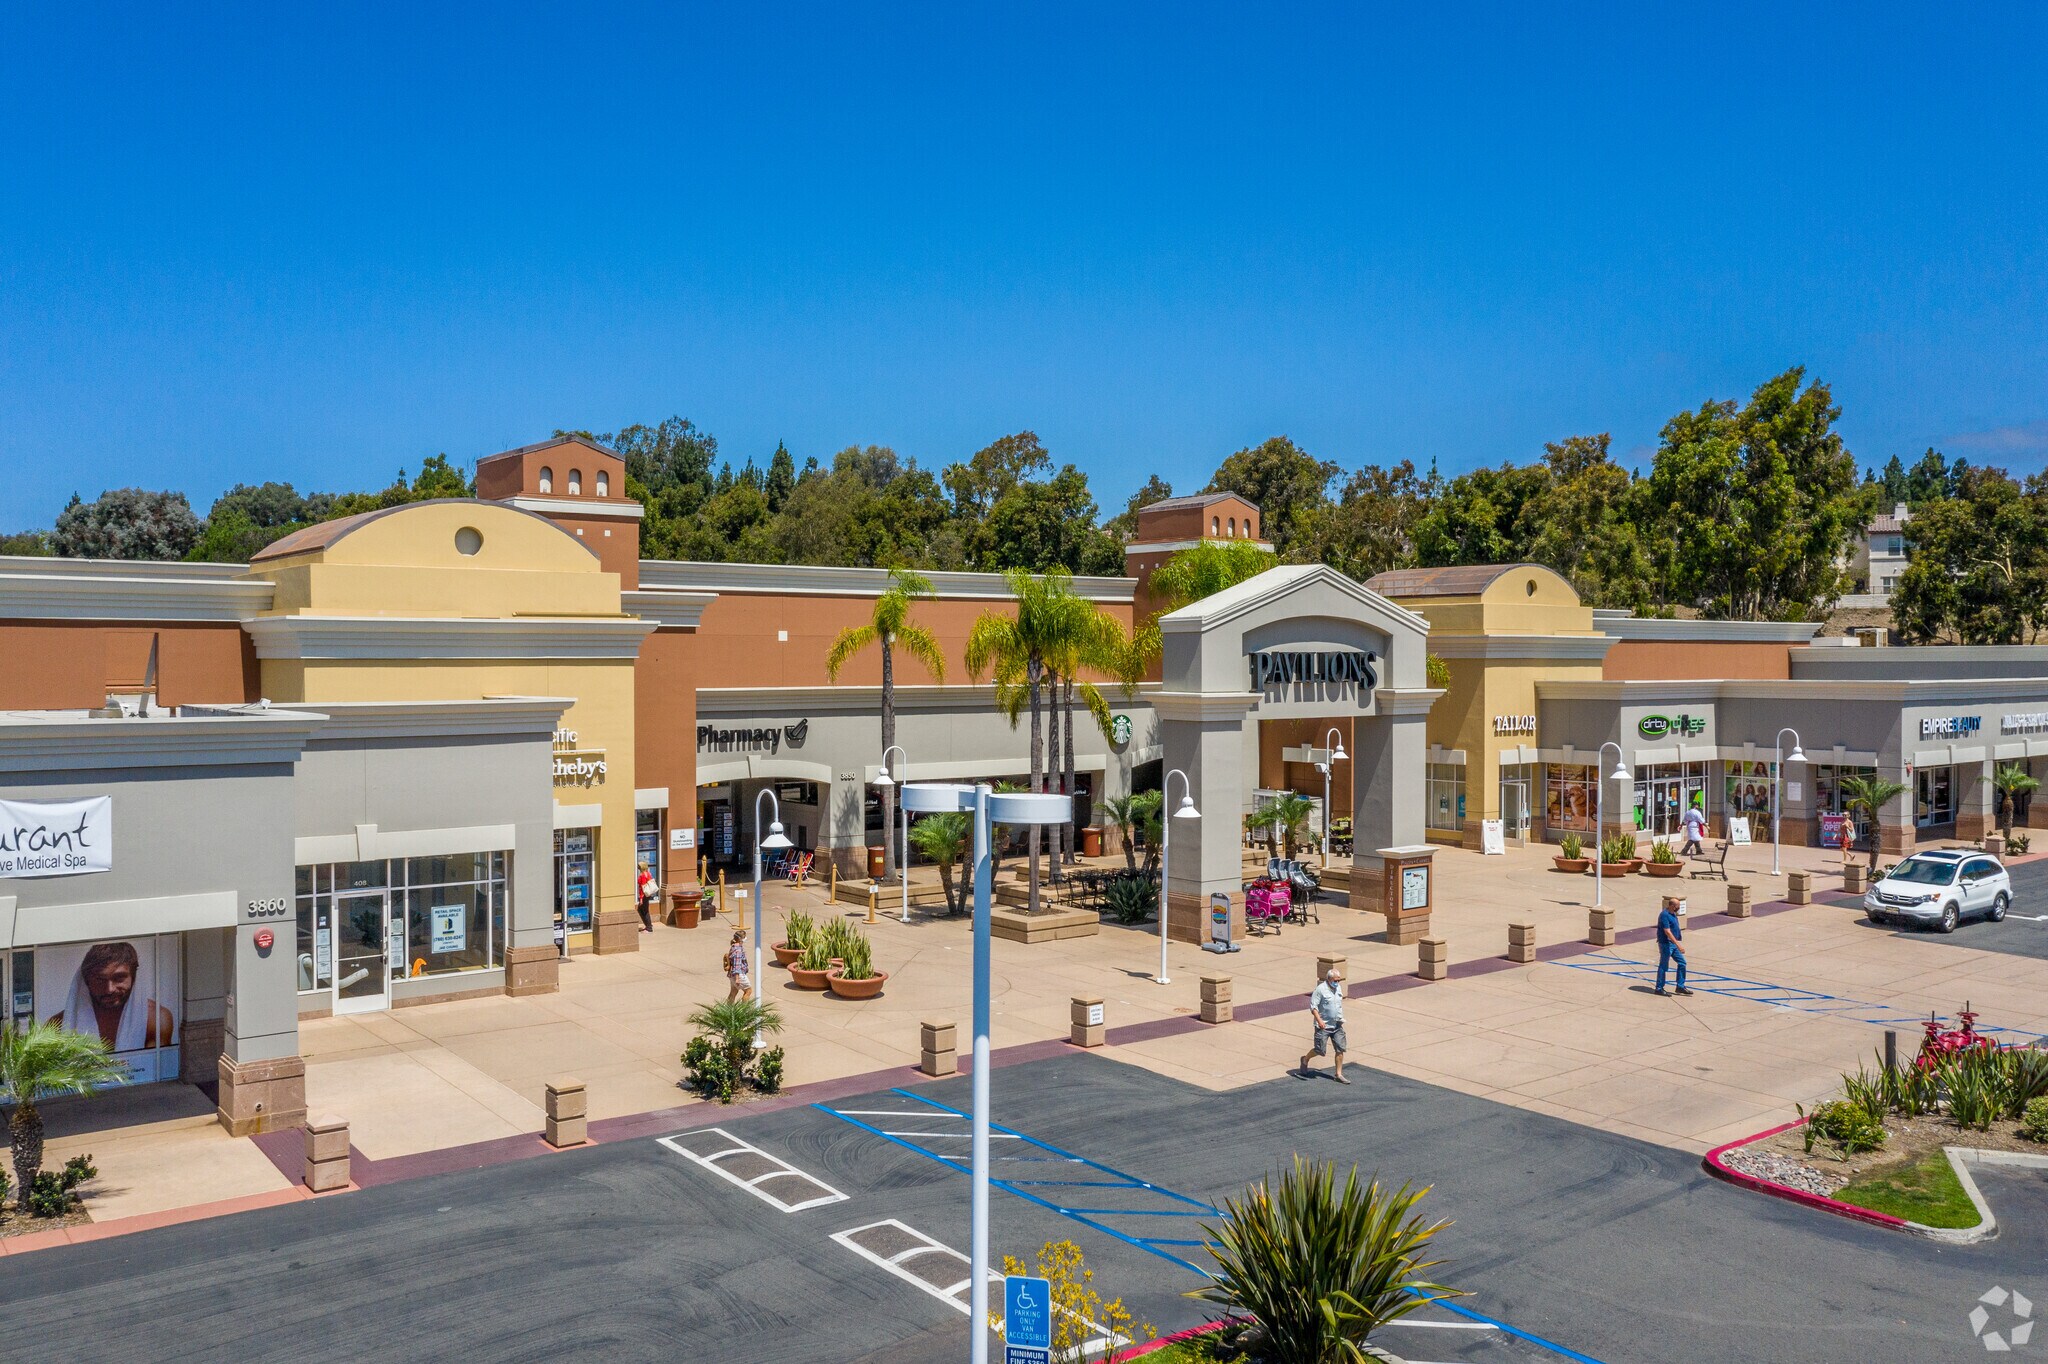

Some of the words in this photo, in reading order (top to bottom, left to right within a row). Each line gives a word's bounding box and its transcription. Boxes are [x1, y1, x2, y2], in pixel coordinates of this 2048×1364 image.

[1250, 651, 1377, 692] PAVILIONS
[1494, 714, 1537, 731] TAILOR
[697, 725, 782, 746] Pharmacy
[17, 854, 60, 870] Medical
[64, 854, 87, 870] Spa
[248, 898, 287, 913] 3860
[1014, 1309, 1041, 1318] PARKING
[1020, 1317, 1036, 1325] ONLY
[1008, 1331, 1048, 1342] ACCESSIBLE
[1010, 1349, 1045, 1360] MINIMUM
